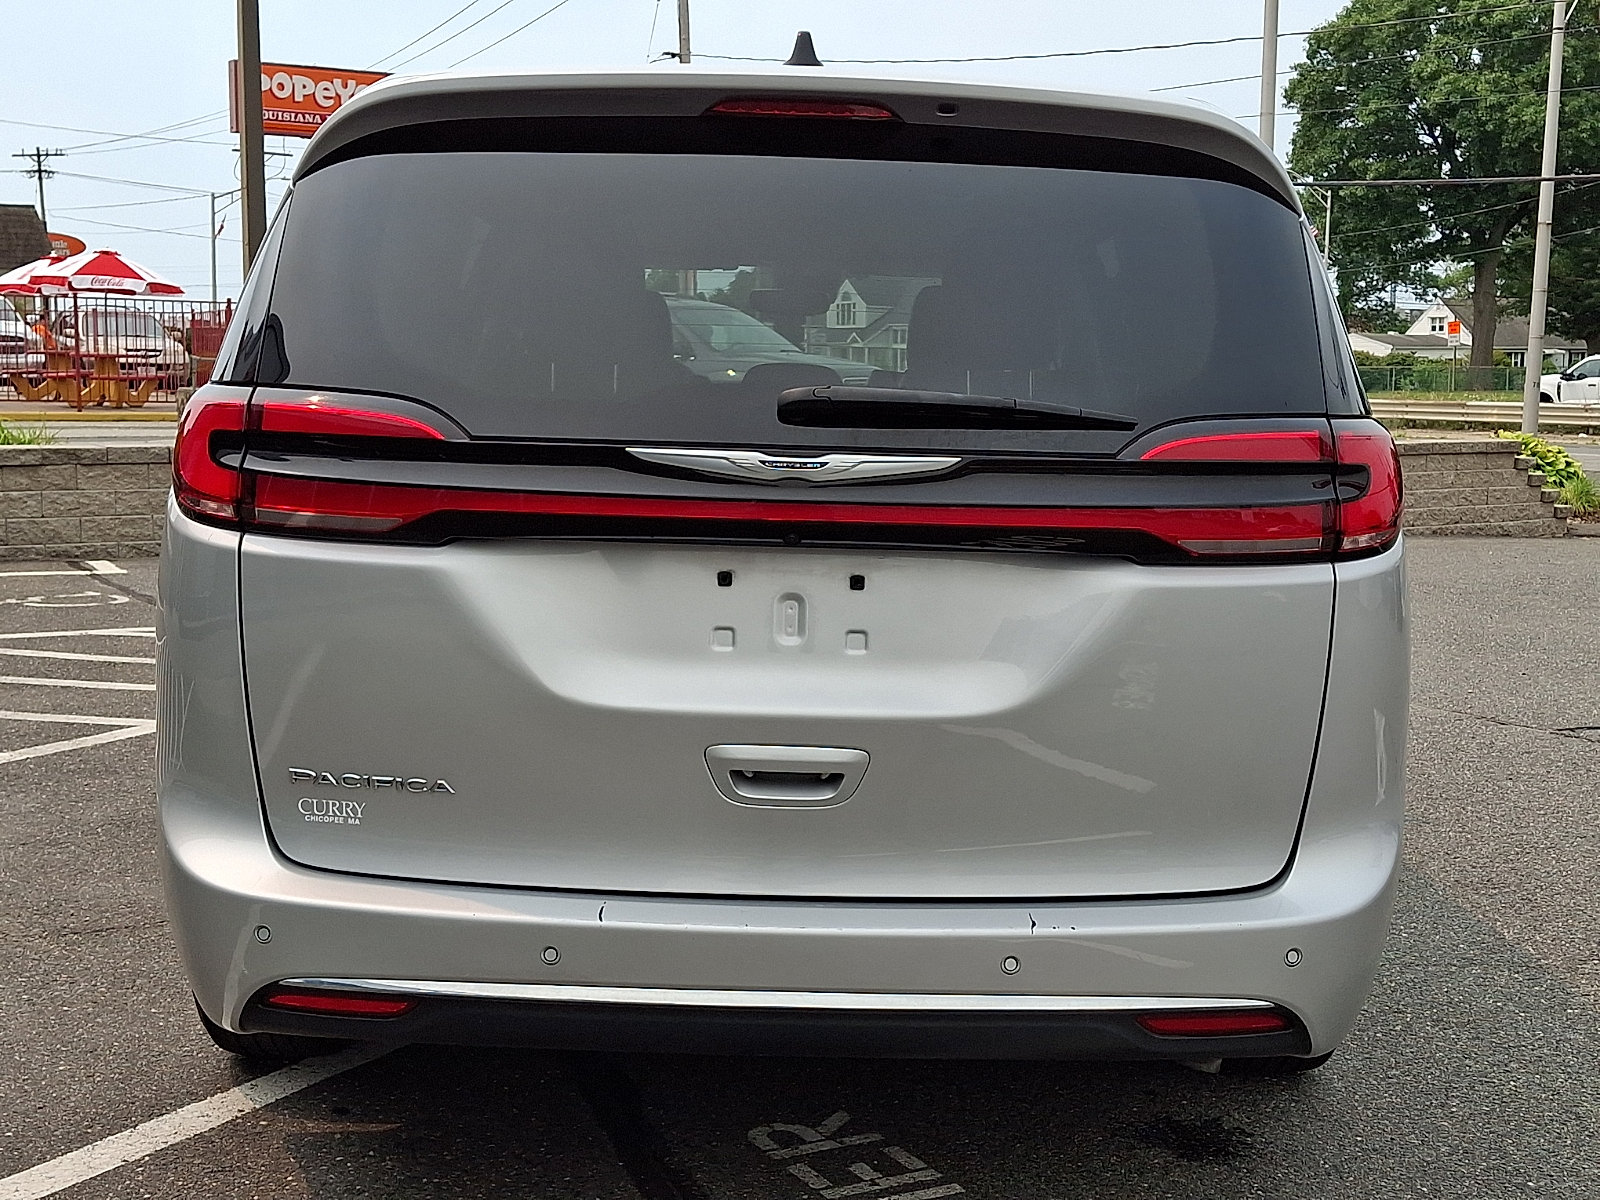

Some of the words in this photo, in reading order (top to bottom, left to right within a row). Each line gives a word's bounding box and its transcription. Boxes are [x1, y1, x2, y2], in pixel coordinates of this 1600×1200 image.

[288, 766, 456, 794] PACIFICA
[297, 797, 366, 818] CURRY
[304, 815, 344, 824] CHICOPEE
[348, 817, 361, 825] MA
